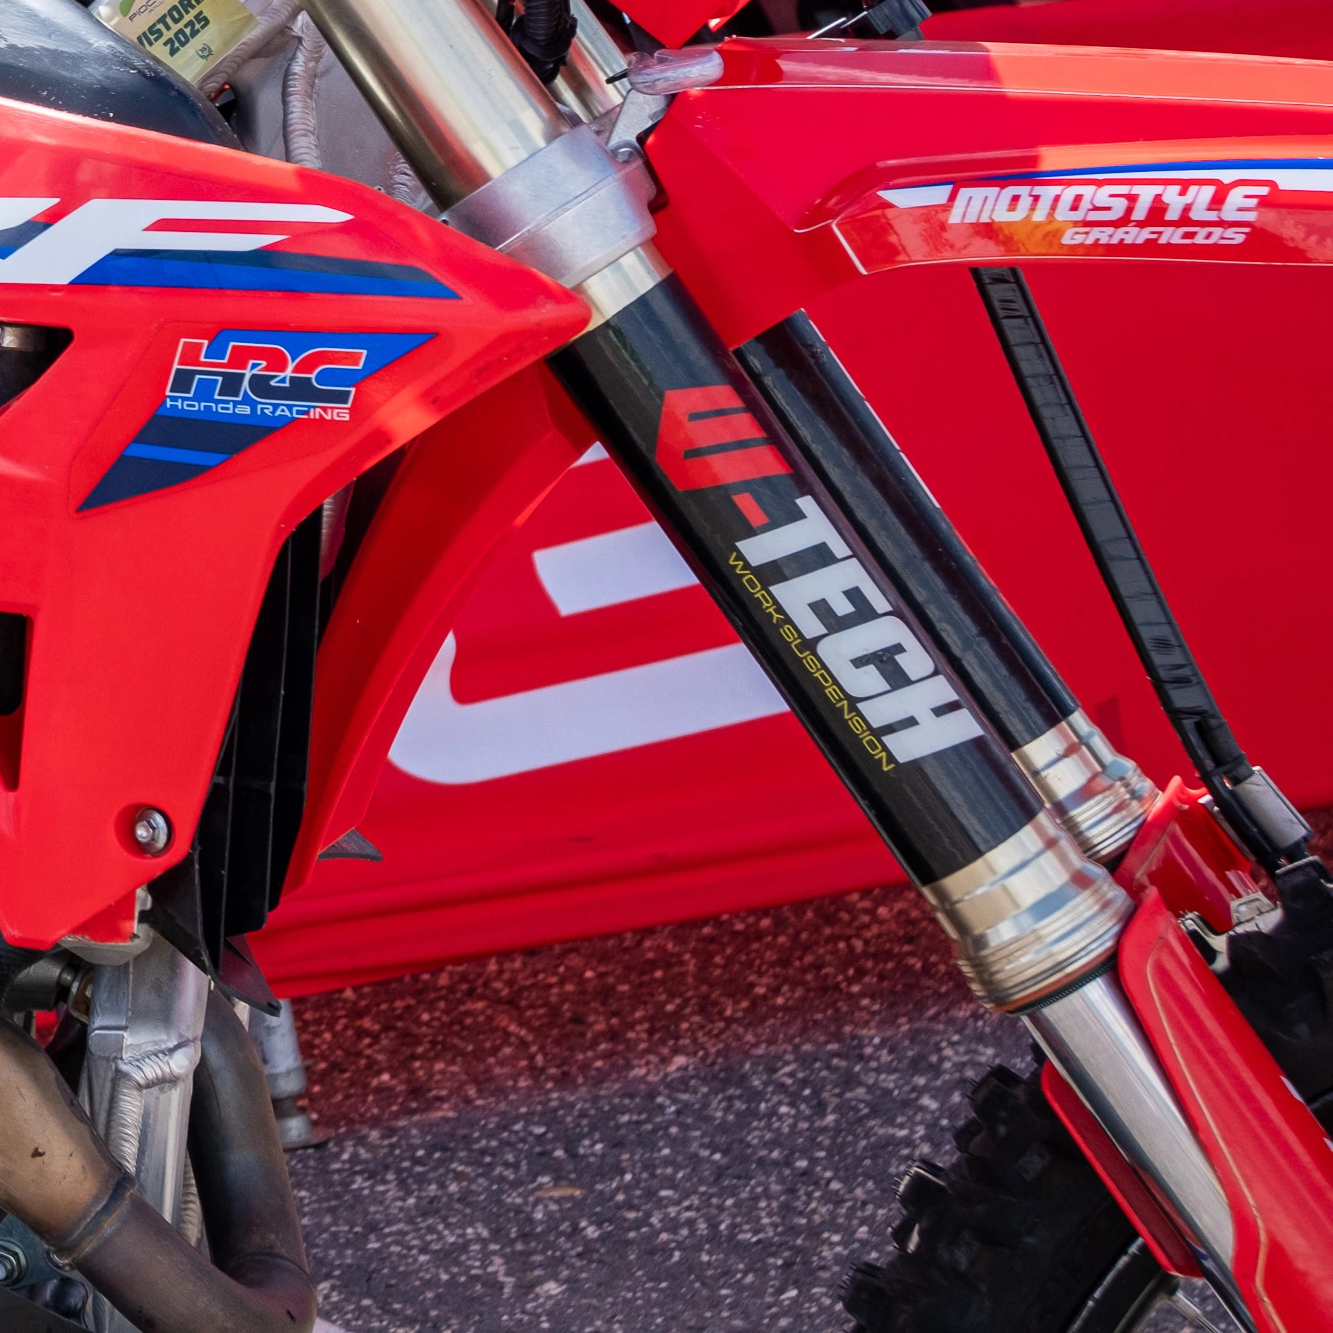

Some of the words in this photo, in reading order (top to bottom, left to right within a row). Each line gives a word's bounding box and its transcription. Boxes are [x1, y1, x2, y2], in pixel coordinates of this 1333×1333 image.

[162, 9, 211, 57] 2025
[947, 184, 1272, 224] MOTOSTYLE
[1060, 222, 1253, 246] GRÁFICOS
[165, 338, 368, 408] HRC
[166, 397, 251, 415] Honda
[257, 404, 350, 421] RACING
[728, 552, 786, 624] WORK
[779, 624, 897, 772] SUSPENSION
